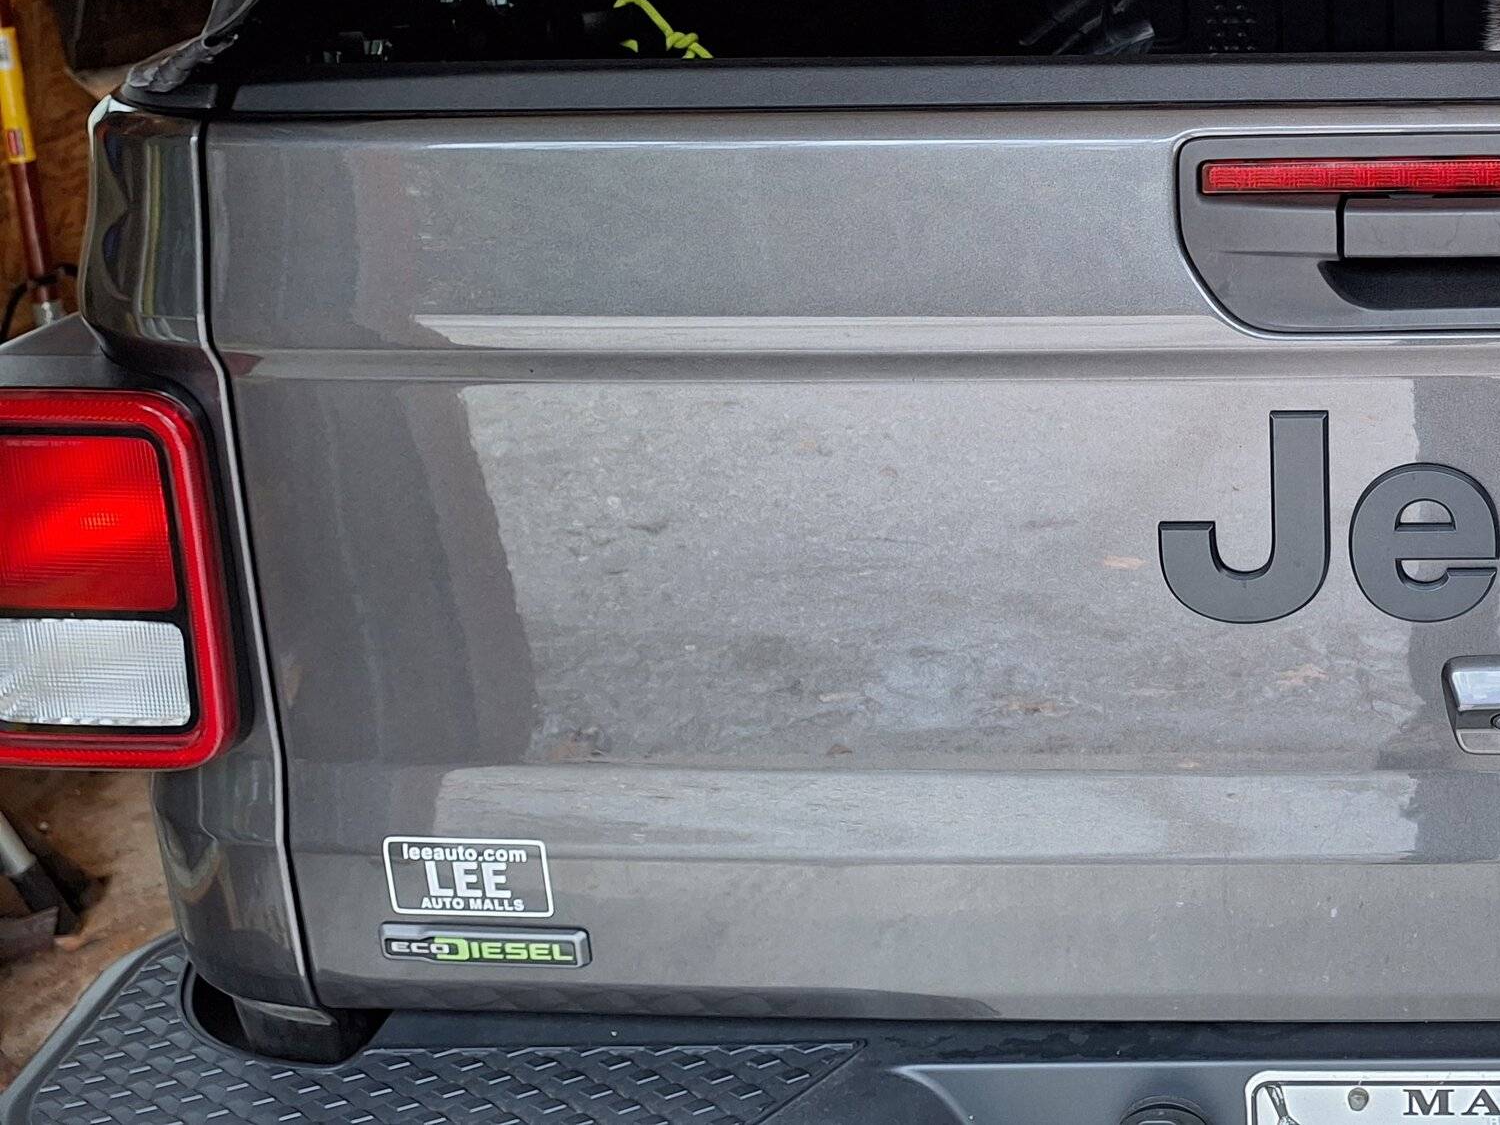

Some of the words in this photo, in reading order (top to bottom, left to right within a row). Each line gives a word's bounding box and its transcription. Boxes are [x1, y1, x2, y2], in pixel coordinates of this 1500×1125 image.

[402, 843, 527, 862] leeauto.com
[424, 861, 512, 898] LEE
[421, 897, 464, 910] AUTO
[469, 898, 525, 911] MALLS
